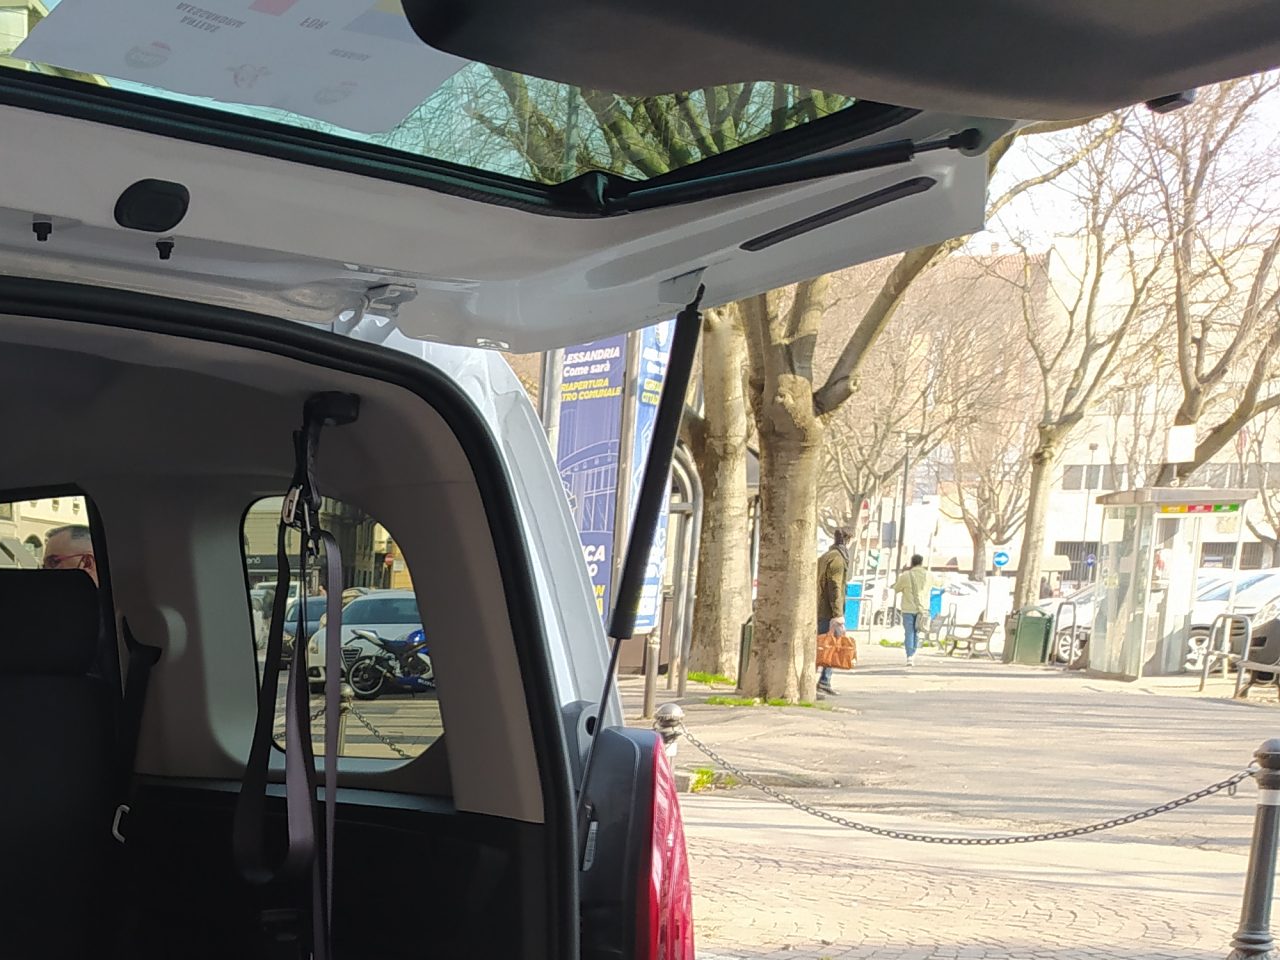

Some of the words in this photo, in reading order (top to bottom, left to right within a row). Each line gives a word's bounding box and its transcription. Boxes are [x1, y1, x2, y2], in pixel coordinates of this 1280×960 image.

[563, 346, 620, 364] LESSANDRIA
[563, 366, 589, 377] Come
[590, 360, 610, 374] sarà
